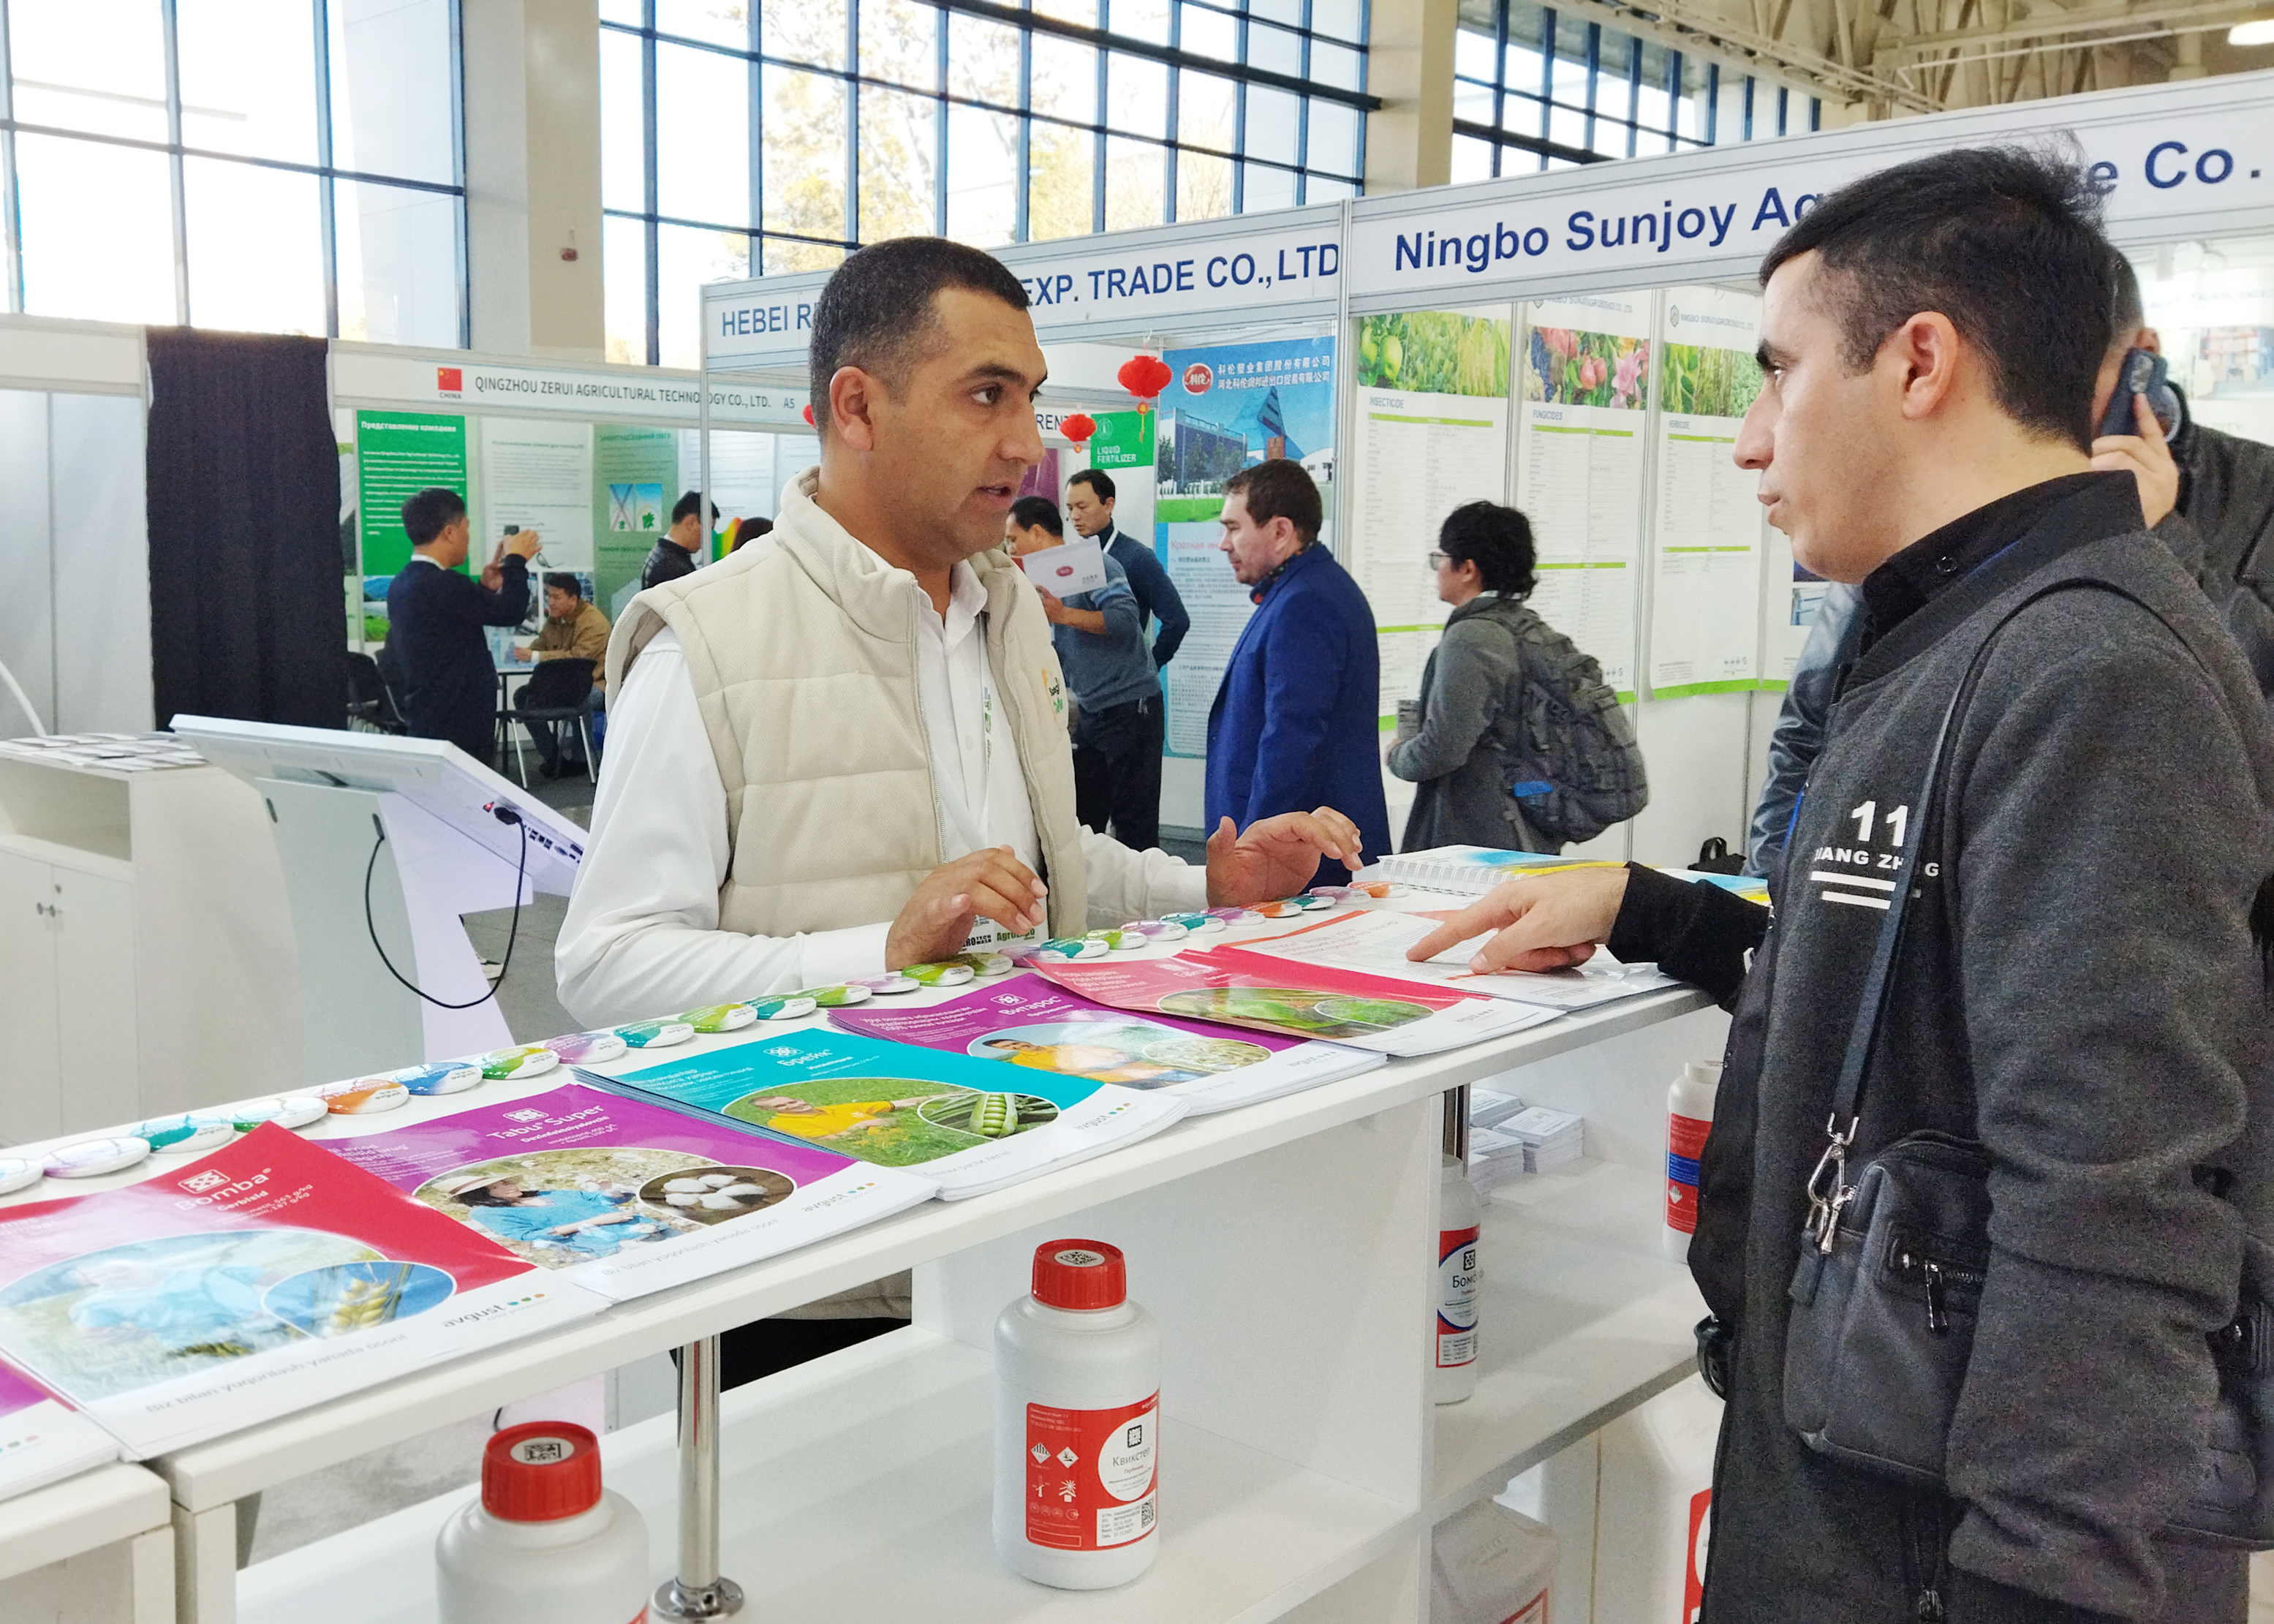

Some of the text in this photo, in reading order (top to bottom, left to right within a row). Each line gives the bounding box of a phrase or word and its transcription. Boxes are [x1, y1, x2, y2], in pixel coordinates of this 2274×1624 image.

[1394, 222, 1549, 273] Ningbo
[1566, 200, 1736, 252] Sunjoy
[1752, 186, 1827, 231] Ag
[722, 305, 788, 336] HEBEI
[1087, 259, 1195, 301] TRADE
[475, 377, 539, 393] QINGZHOU
[540, 379, 573, 396] ZERUI
[575, 385, 657, 401] AGRICULTURAL
[658, 389, 727, 405] TECHNOOGY
[749, 395, 772, 409] LTD.
[783, 398, 795, 409] A5
[1369, 396, 1405, 409] INSECTICIDE
[1036, 414, 1068, 431] REN
[1533, 409, 1563, 420] FUNGICIDES
[1097, 453, 1137, 463] FERTILIZER
[1851, 801, 1908, 847] 11
[544, 1105, 604, 1126] Super
[801, 1193, 847, 1213] avgust
[442, 1304, 507, 1328] avgust
[175, 1388, 219, 1405] bilan
[306, 1345, 365, 1367] yanada
[1112, 1447, 1151, 1467] Квикстеп
